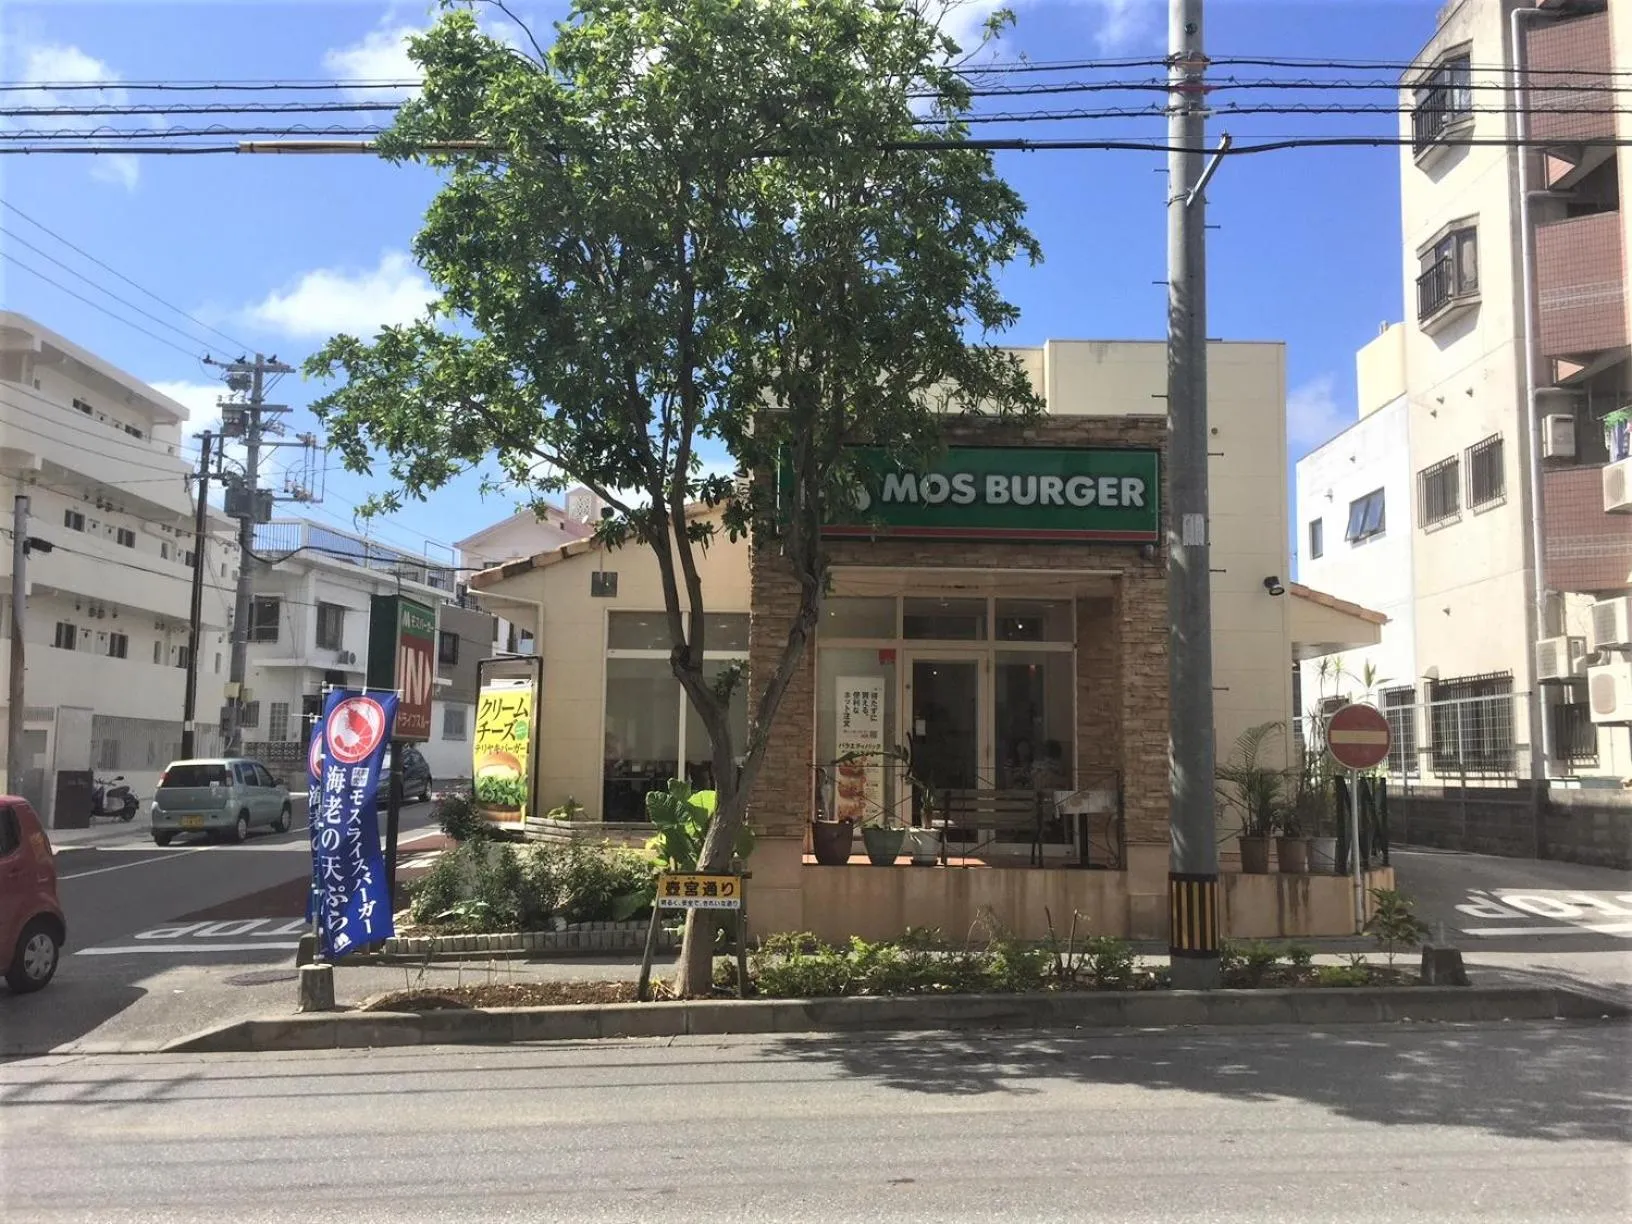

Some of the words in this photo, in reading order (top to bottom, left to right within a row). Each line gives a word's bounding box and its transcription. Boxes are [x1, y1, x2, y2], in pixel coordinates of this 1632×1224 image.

[882, 472, 976, 505] MOS
[985, 474, 1145, 508] BURGER
[400, 645, 424, 705] IN
[476, 719, 518, 742] チーズ
[478, 697, 529, 720] クリーム
[321, 765, 349, 932] 海老の天ぷら
[346, 788, 377, 935] モスライスバーガー
